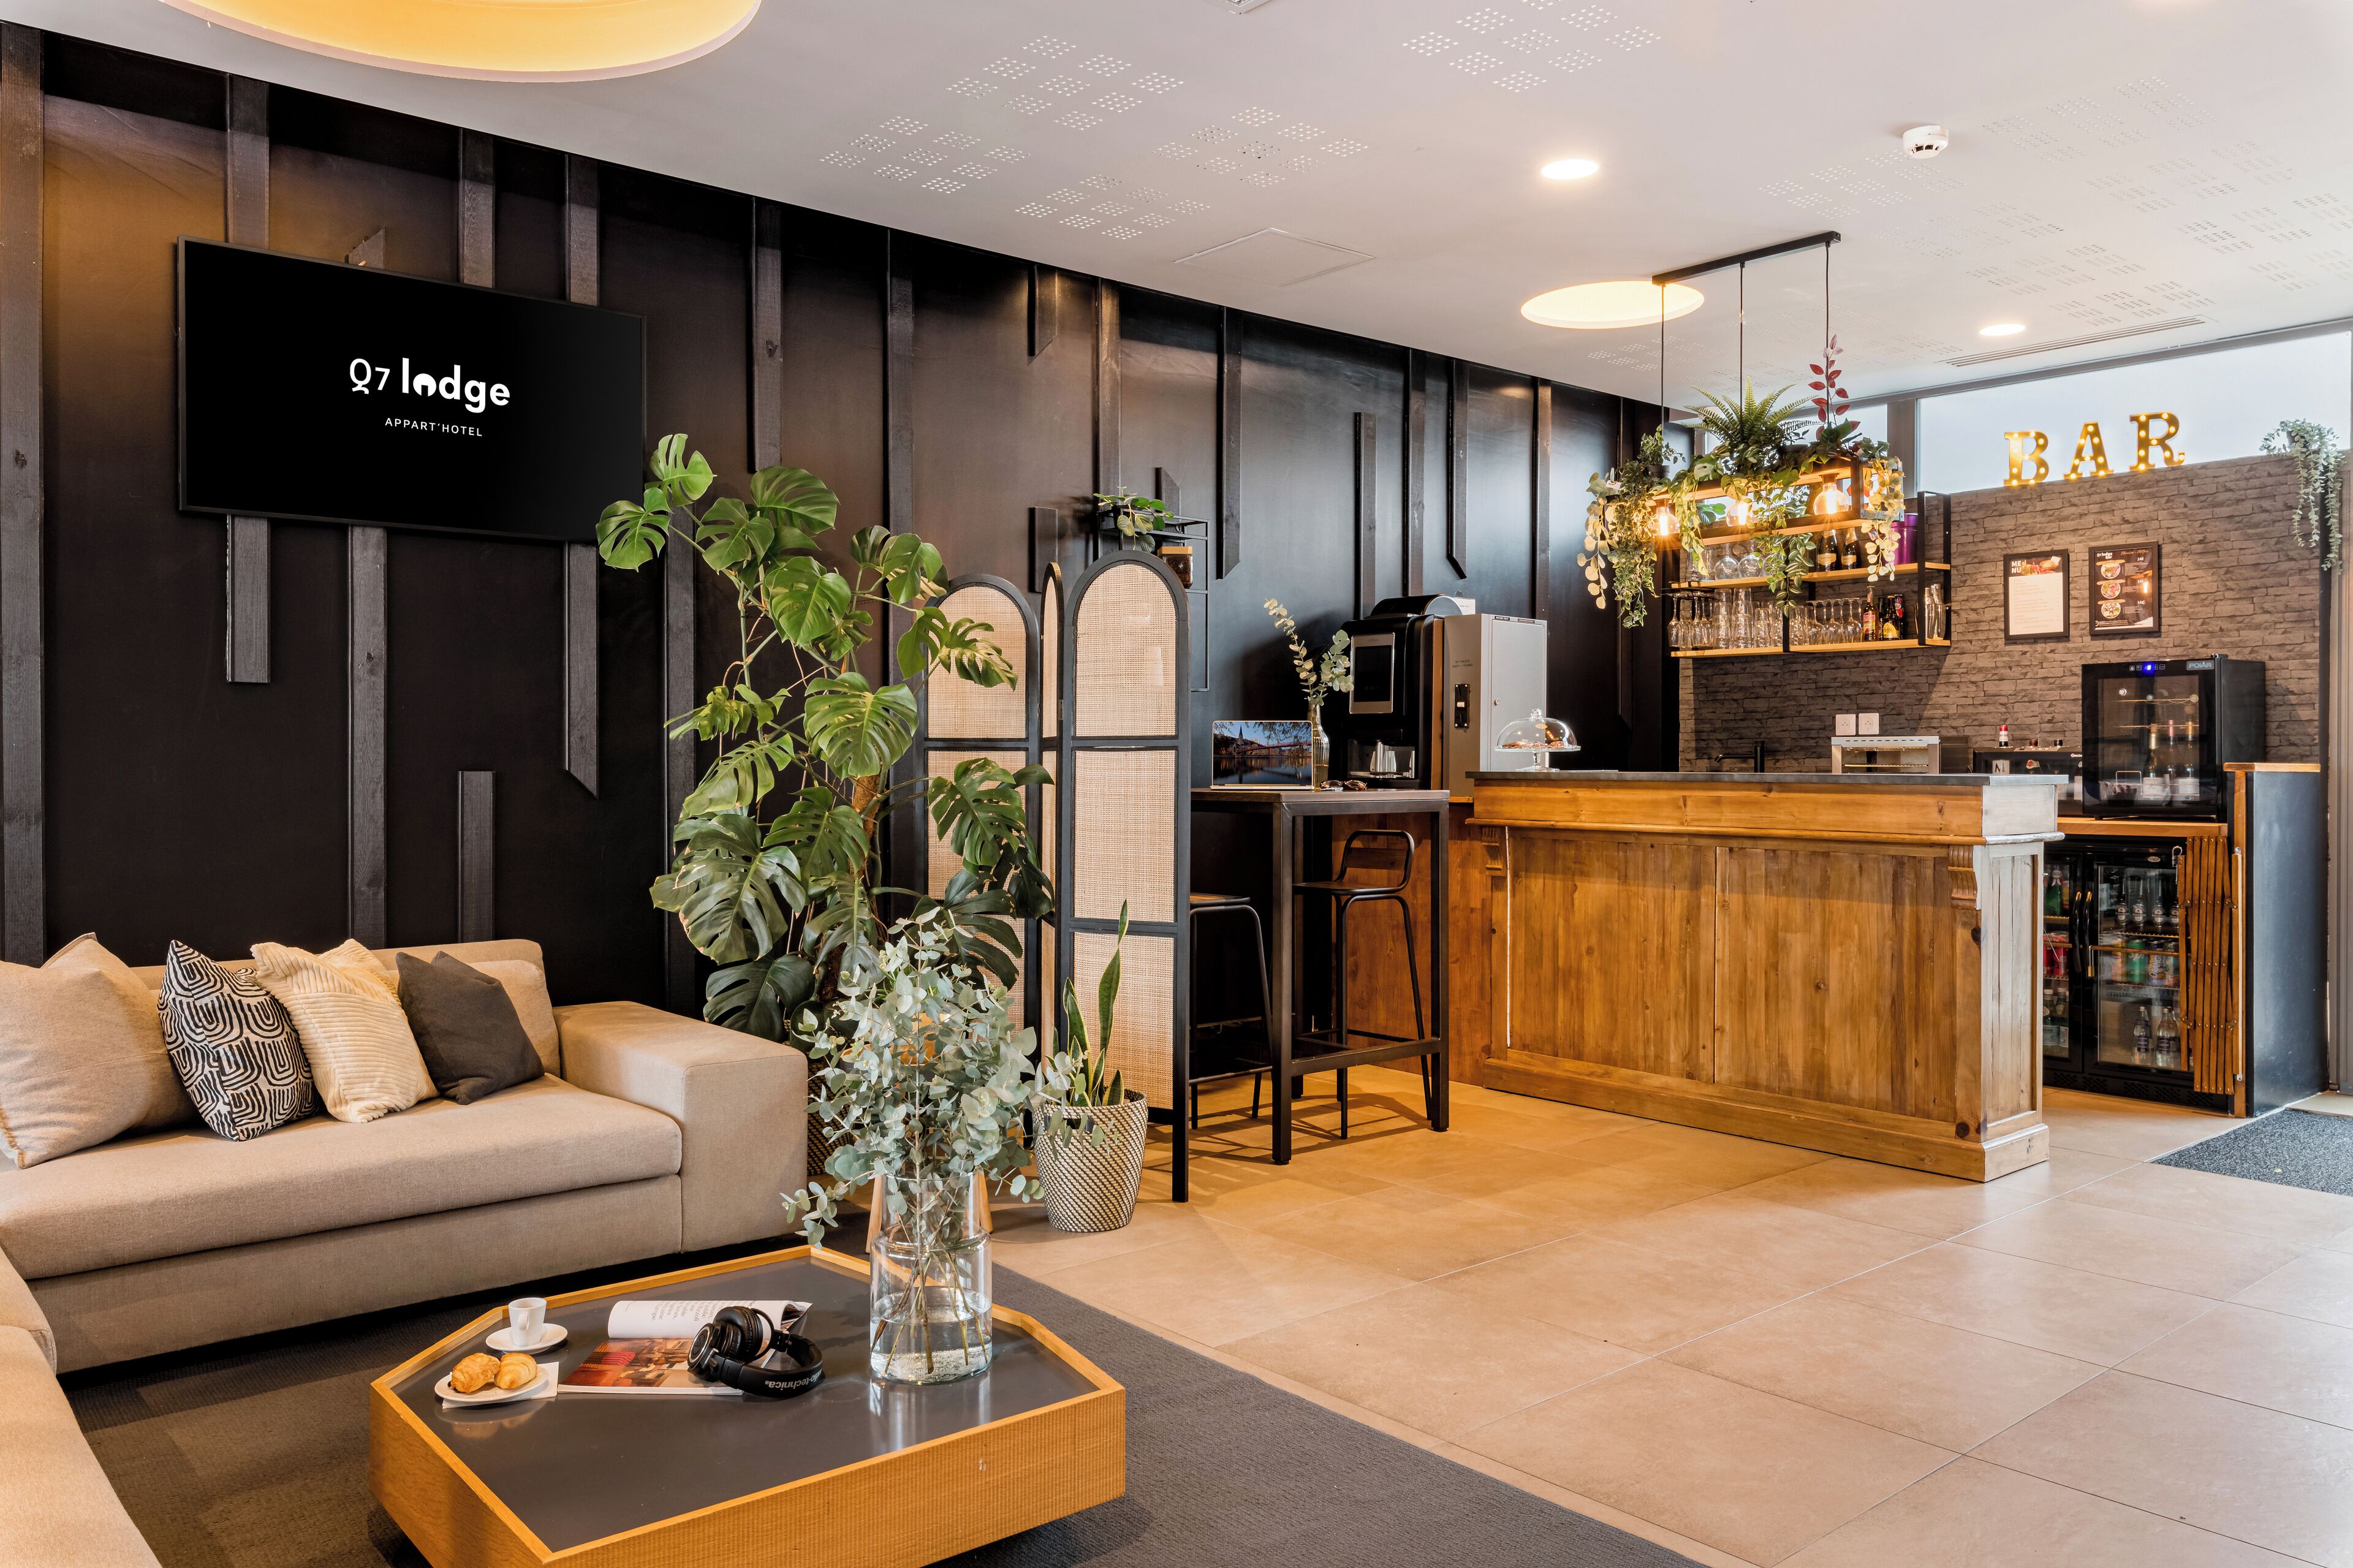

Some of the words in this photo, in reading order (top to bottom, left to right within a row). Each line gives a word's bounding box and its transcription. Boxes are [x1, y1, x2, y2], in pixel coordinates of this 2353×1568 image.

[349, 358, 390, 395] Q7
[402, 357, 510, 414] lodge
[384, 417, 483, 437] APPART'HOTEL
[2003, 411, 2186, 487] BAR
